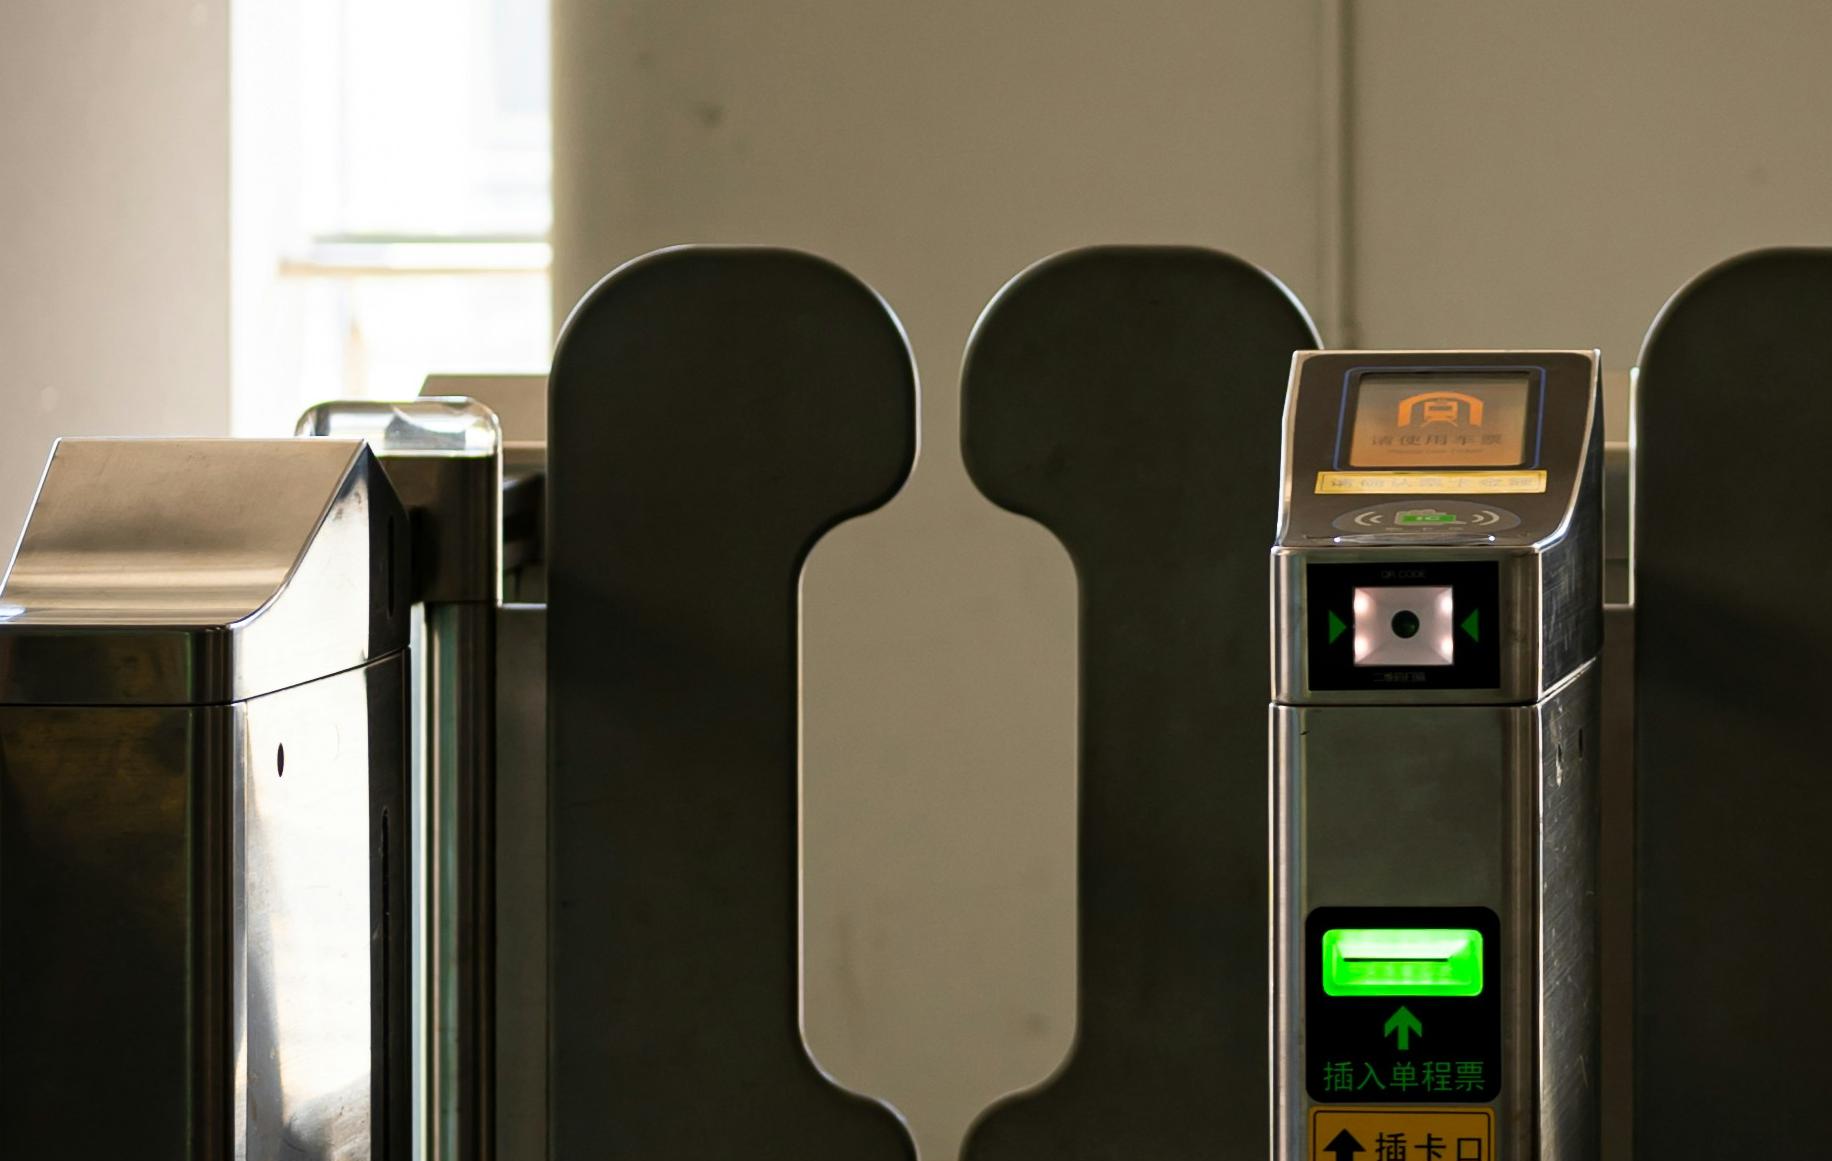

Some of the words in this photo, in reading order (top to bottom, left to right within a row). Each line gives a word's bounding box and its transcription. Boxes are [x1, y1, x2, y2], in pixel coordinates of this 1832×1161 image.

[1323, 1061, 1486, 1092] 插入单程票
